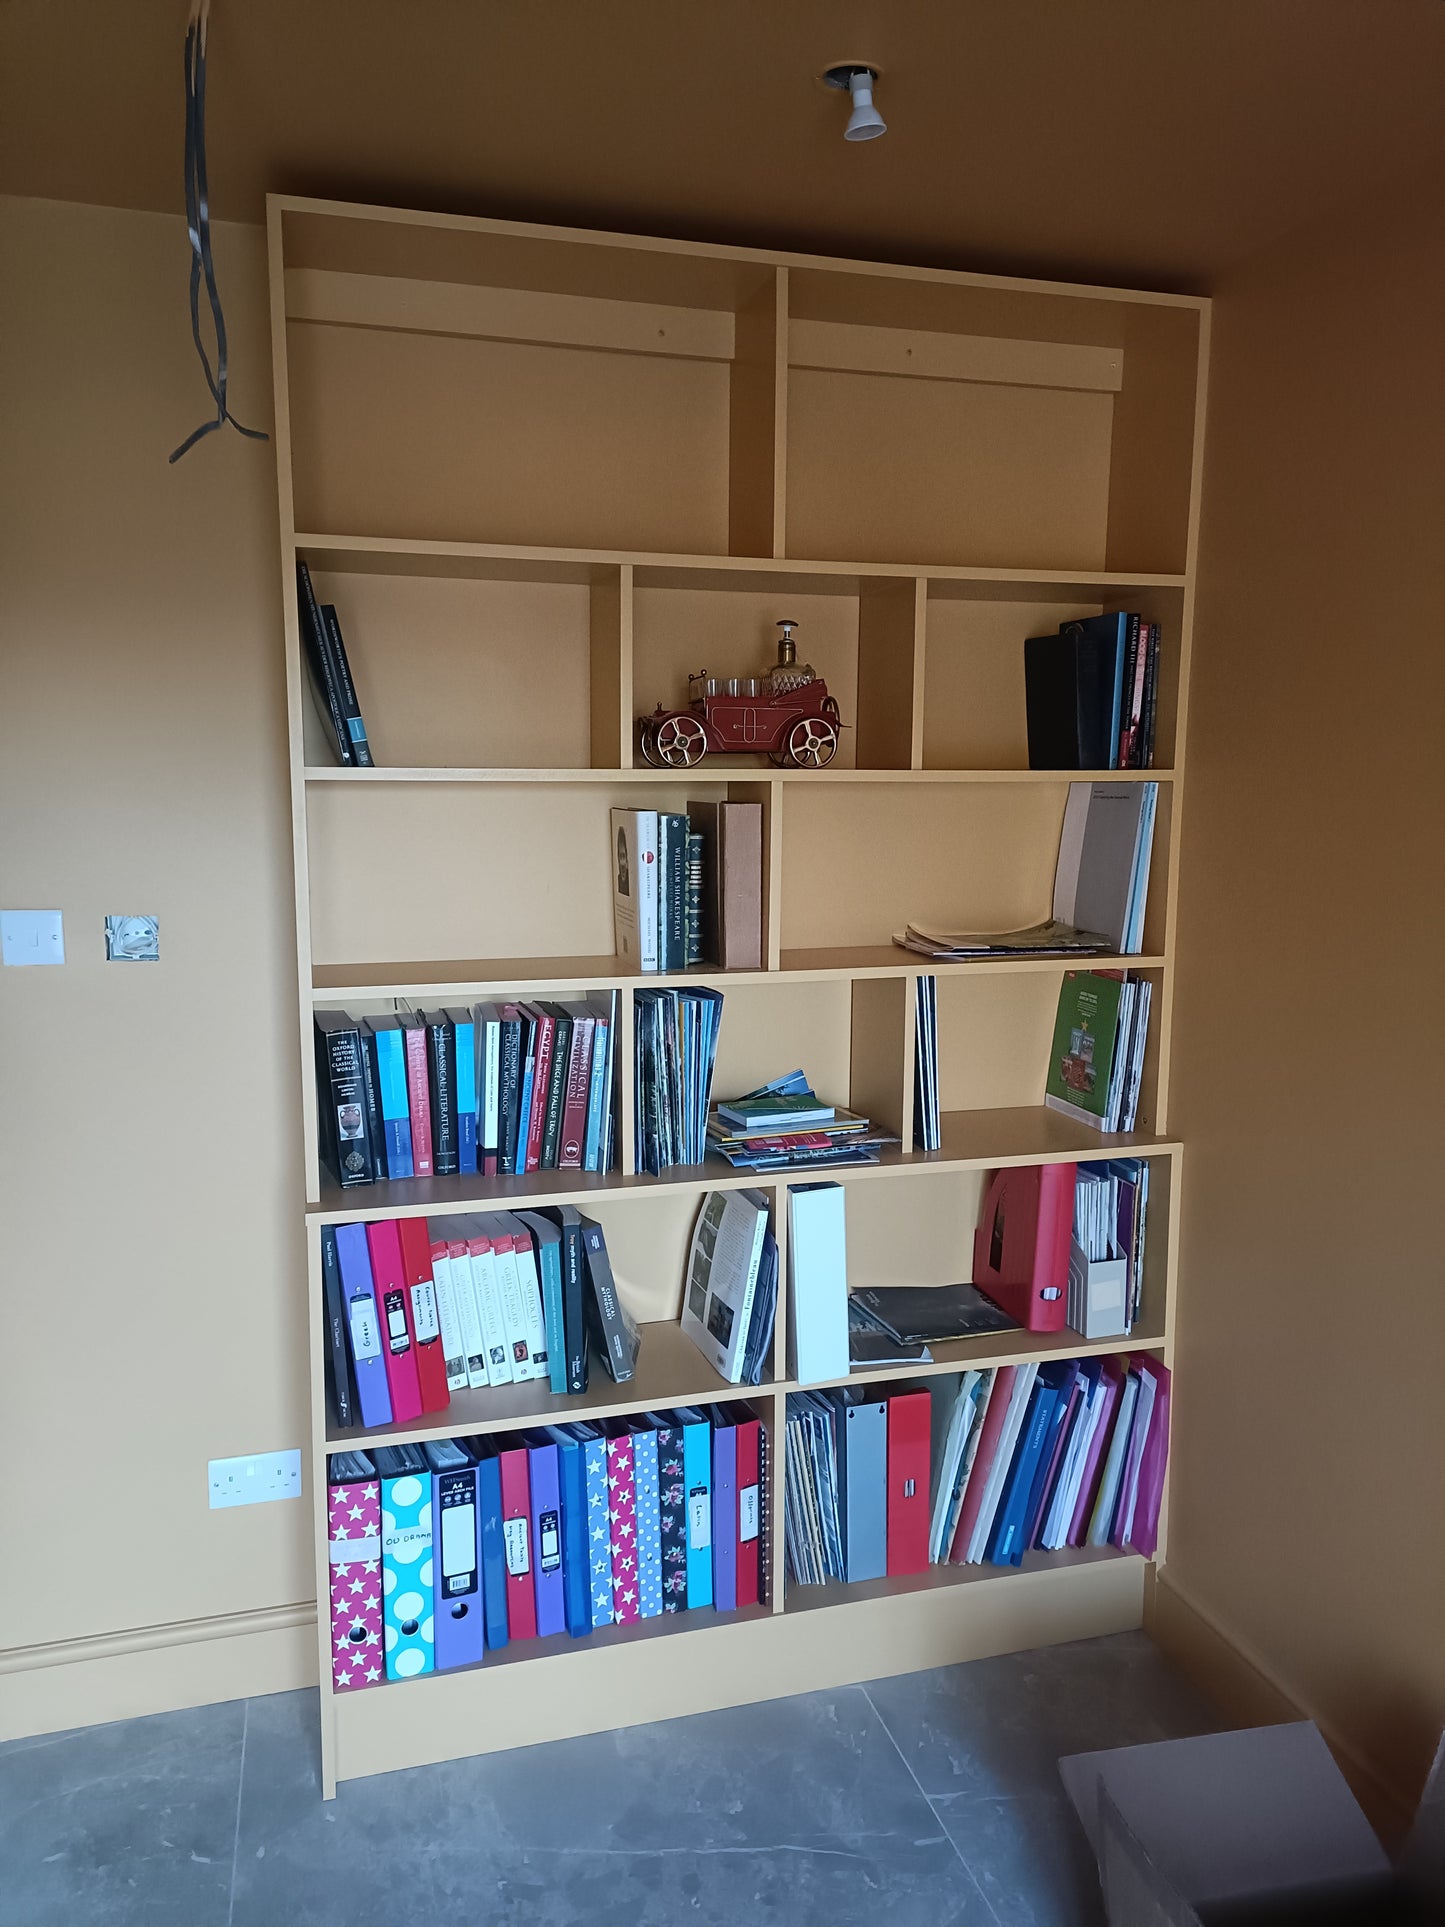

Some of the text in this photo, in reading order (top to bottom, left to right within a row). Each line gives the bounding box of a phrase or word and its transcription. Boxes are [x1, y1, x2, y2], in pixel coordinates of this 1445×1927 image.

[1130, 617, 1139, 652] RICHARD
[338, 660, 348, 679] POETRY
[345, 690, 354, 705] PROSE
[541, 1023, 552, 1060] EGYPT
[332, 1060, 359, 1068] CLASSICAL
[438, 1043, 447, 1085] CLASSICAL
[511, 1080, 515, 1089] OF
[570, 1035, 581, 1098] CIVILIZATION
[577, 1036, 589, 1099] CLASSICAL
[368, 1088, 376, 1112] HOMER
[440, 1088, 449, 1141] LITERATURE
[548, 1051, 564, 1137] THE SIEGE AND FALL OF TROY
[481, 1267, 491, 1302] ARCHAIC
[486, 1306, 497, 1336] GREECE
[503, 1266, 519, 1327] GREEK TRAGEDY
[525, 1279, 539, 1328] SOPHOCLES
[600, 1286, 613, 1320] MYTHOLOGY
[605, 1287, 617, 1318] CLASSICAL
[744, 1259, 758, 1310] Fontainebleau
[438, 1276, 453, 1346] LATIN LITERATURE
[362, 1322, 370, 1347] Greek
[1033, 1409, 1048, 1449] STATEMENTS
[452, 1482, 463, 1490] A4
